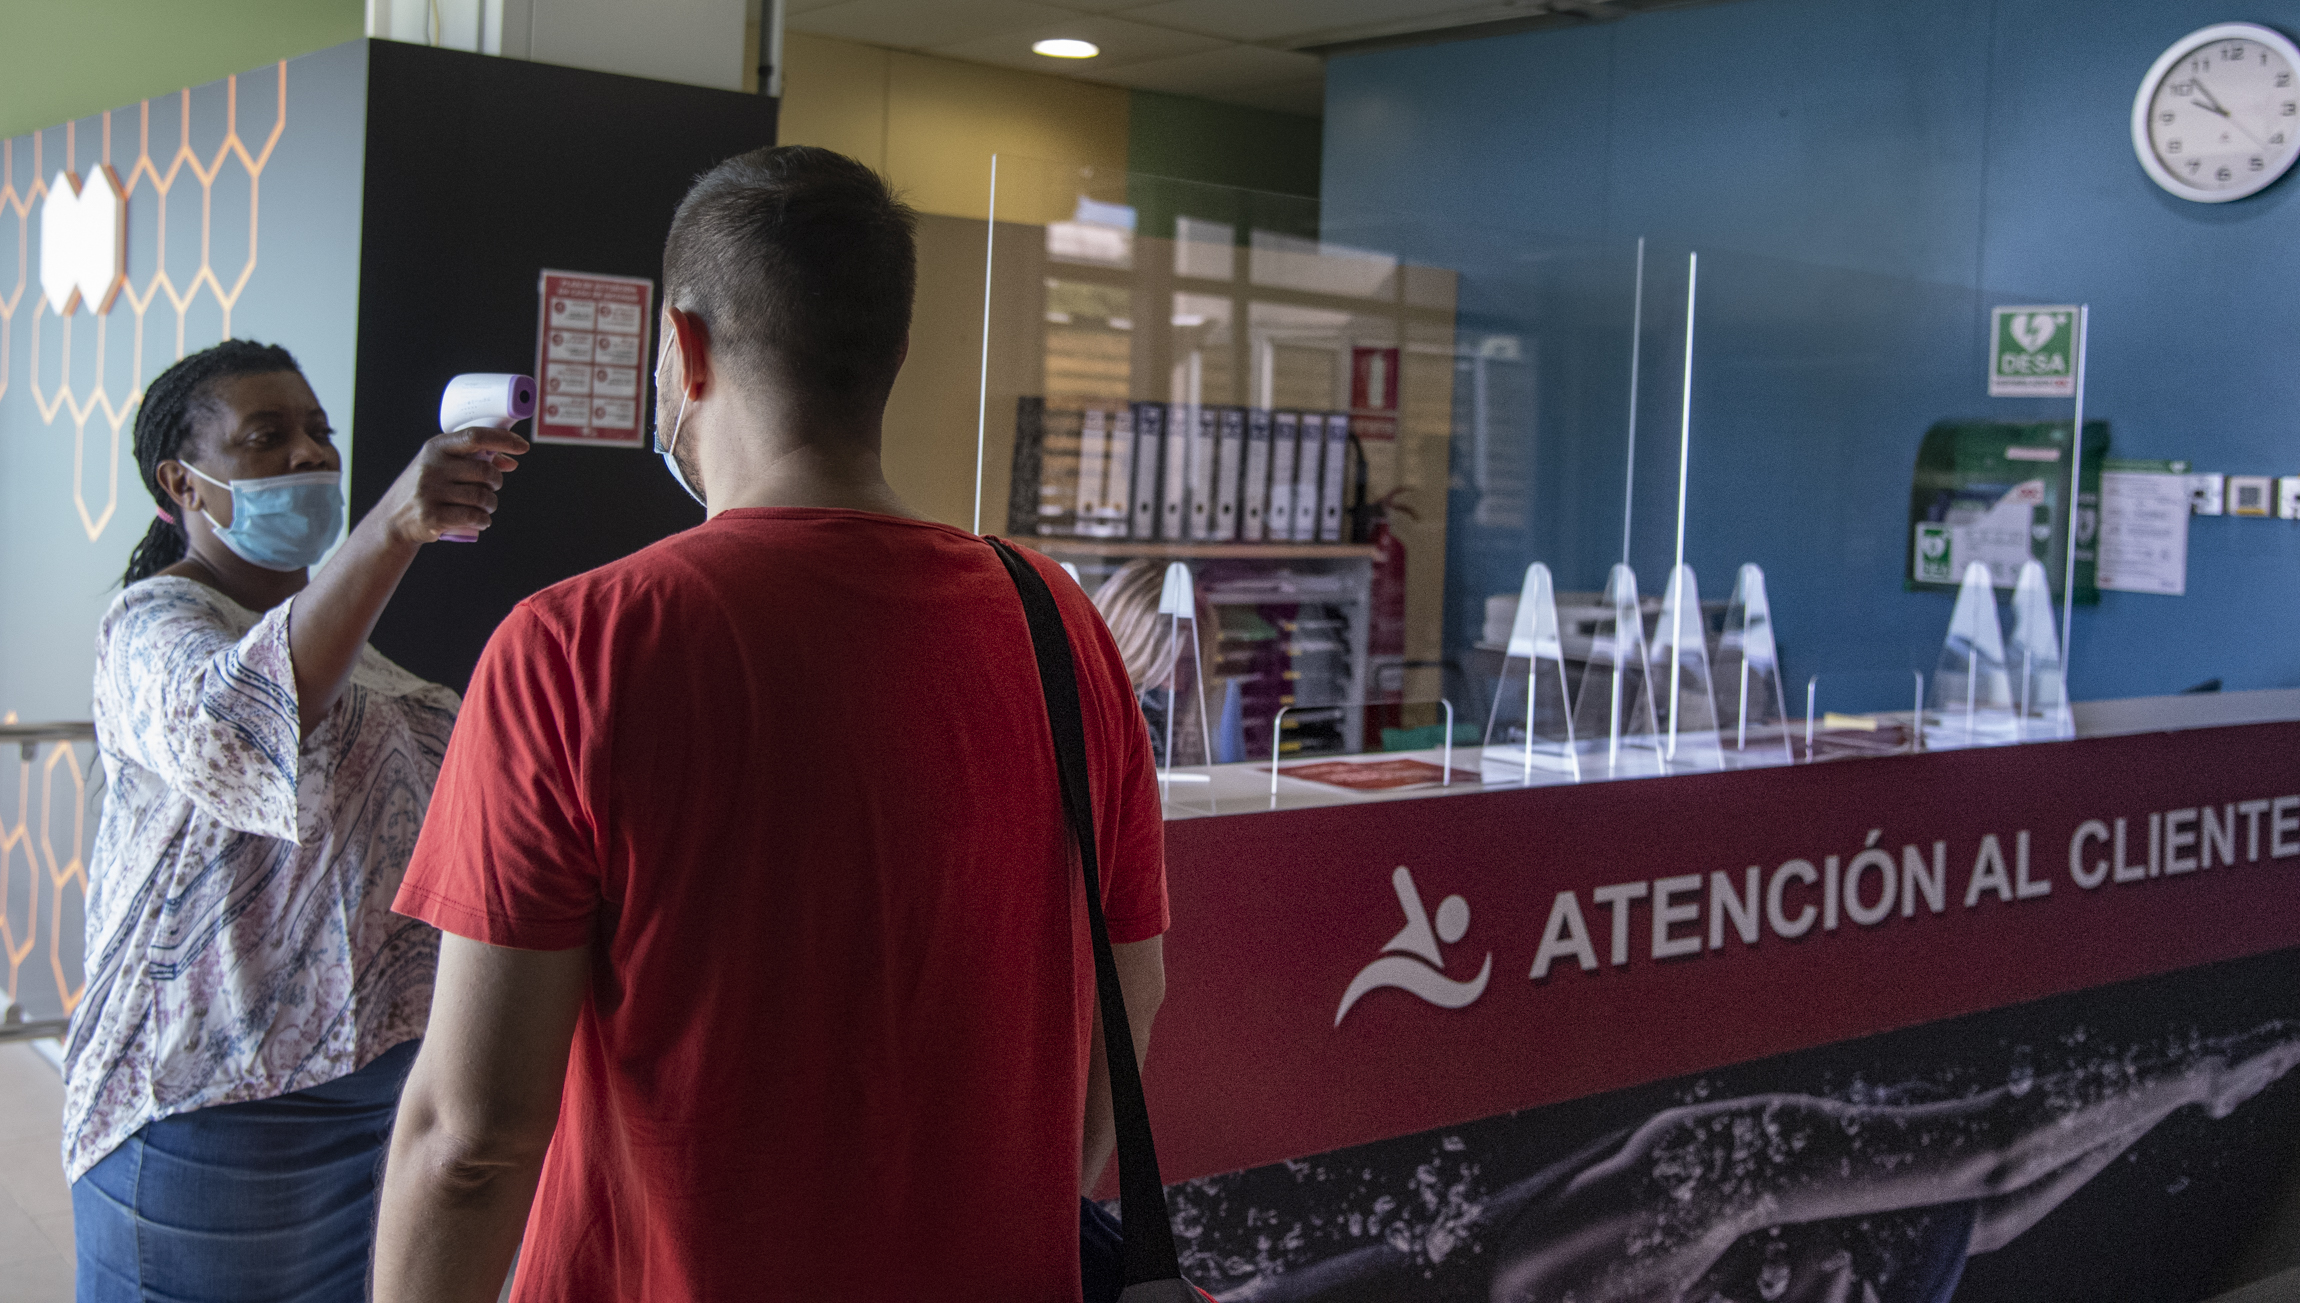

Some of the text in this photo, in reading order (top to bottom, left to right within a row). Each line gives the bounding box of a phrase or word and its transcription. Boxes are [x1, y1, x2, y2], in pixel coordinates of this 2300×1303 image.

[2221, 47, 2244, 61] 12
[2260, 53, 2268, 66] 1
[2191, 59, 2210, 73] 11
[2275, 73, 2290, 88] 2
[2170, 82, 2194, 97] 10
[2282, 101, 2296, 116] 3
[2161, 111, 2175, 123] 9
[2269, 132, 2285, 145] 4
[2168, 140, 2182, 153] 8
[2187, 159, 2201, 173] 7
[2249, 157, 2264, 171] 5
[2217, 167, 2232, 181] 6
[2001, 353, 2066, 374] DESA
[1529, 795, 2300, 979] ATENCIÓN AL CLIENTE
